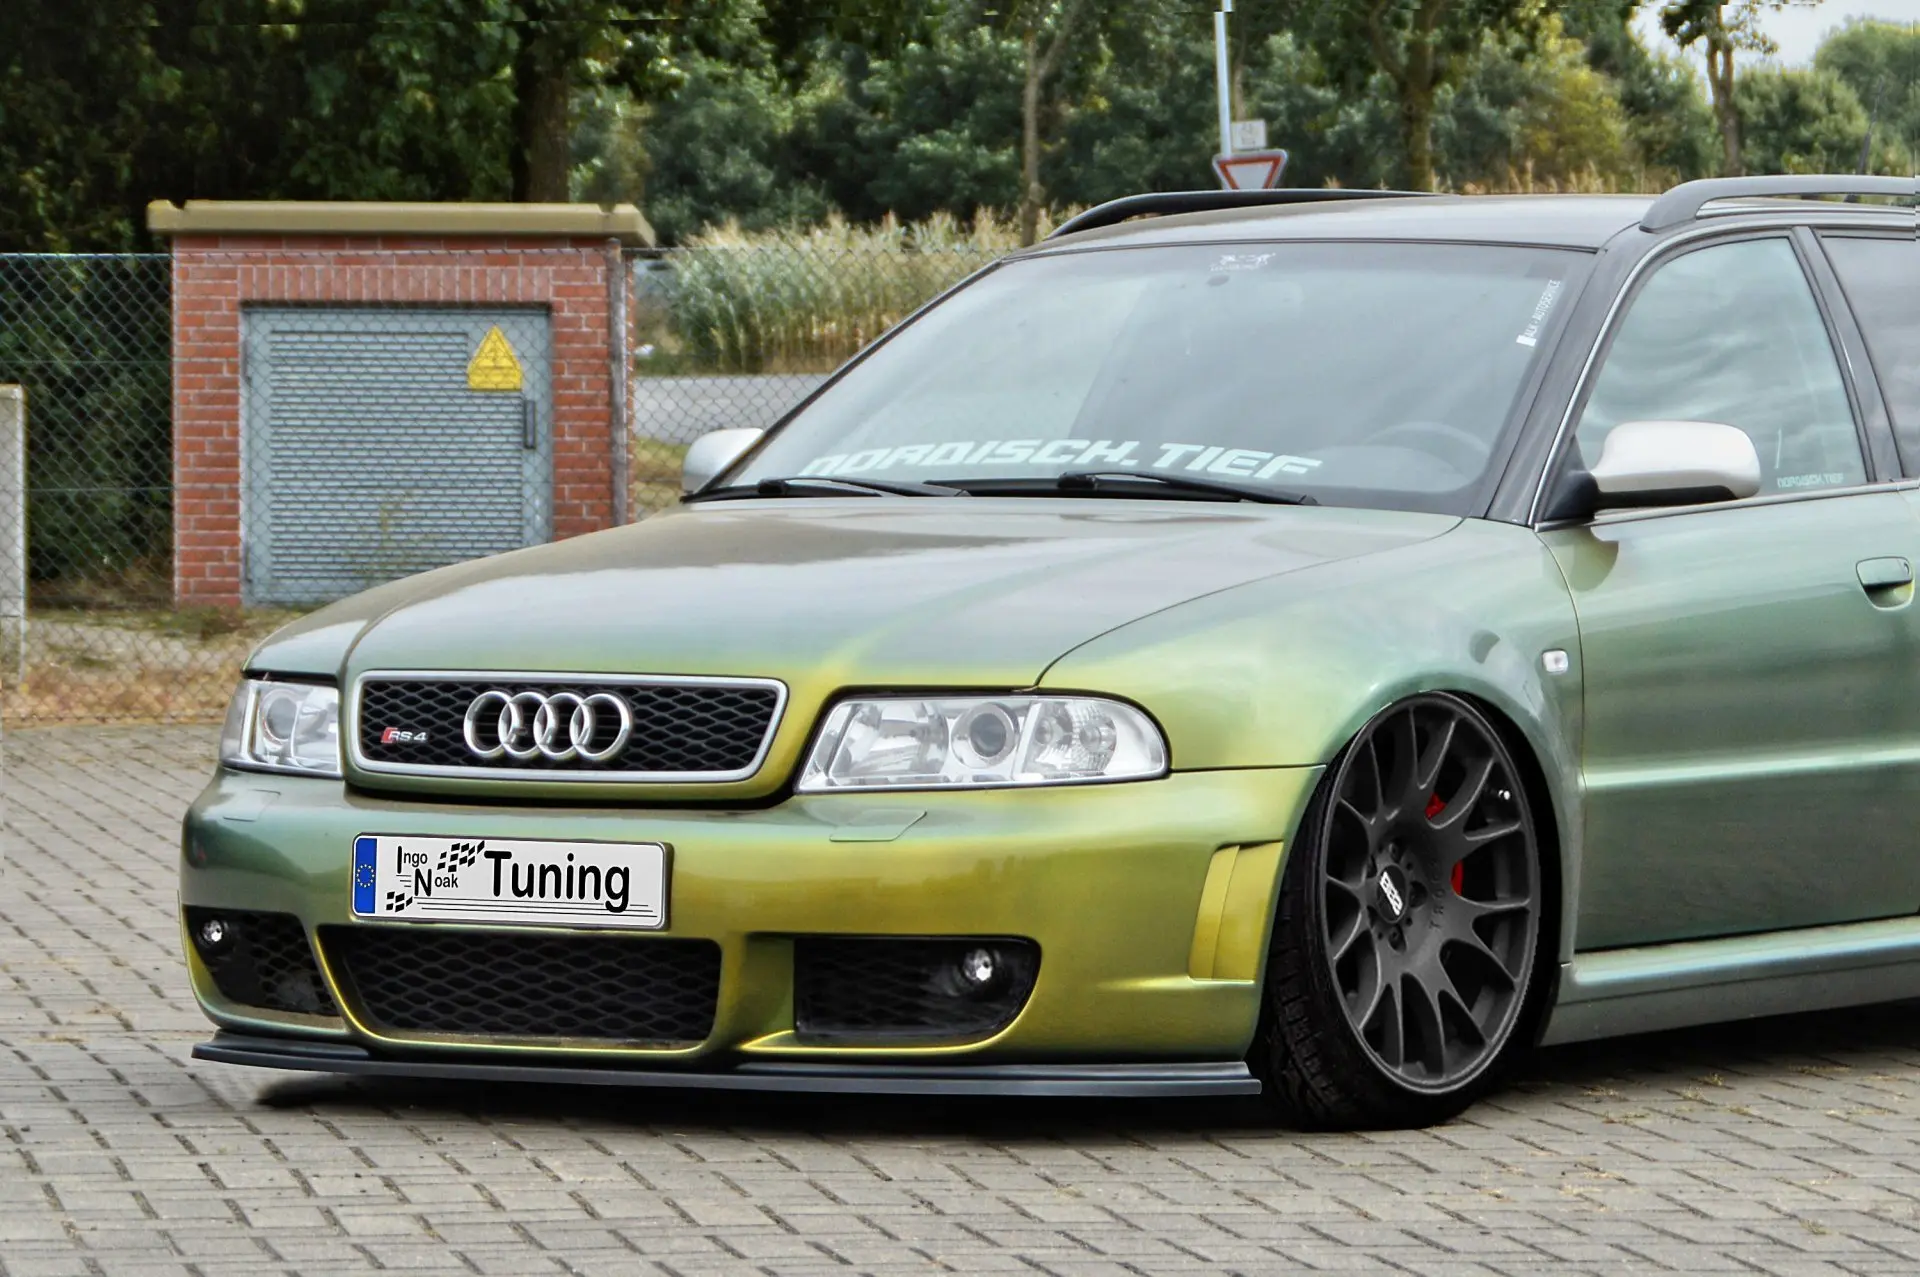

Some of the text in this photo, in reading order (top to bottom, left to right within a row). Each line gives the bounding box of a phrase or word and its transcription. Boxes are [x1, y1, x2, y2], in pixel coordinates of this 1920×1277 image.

[1151, 442, 1323, 479] TIEF
[396, 845, 428, 874] Ingo
[414, 868, 459, 897] Noak
[483, 850, 630, 913] Tuning
